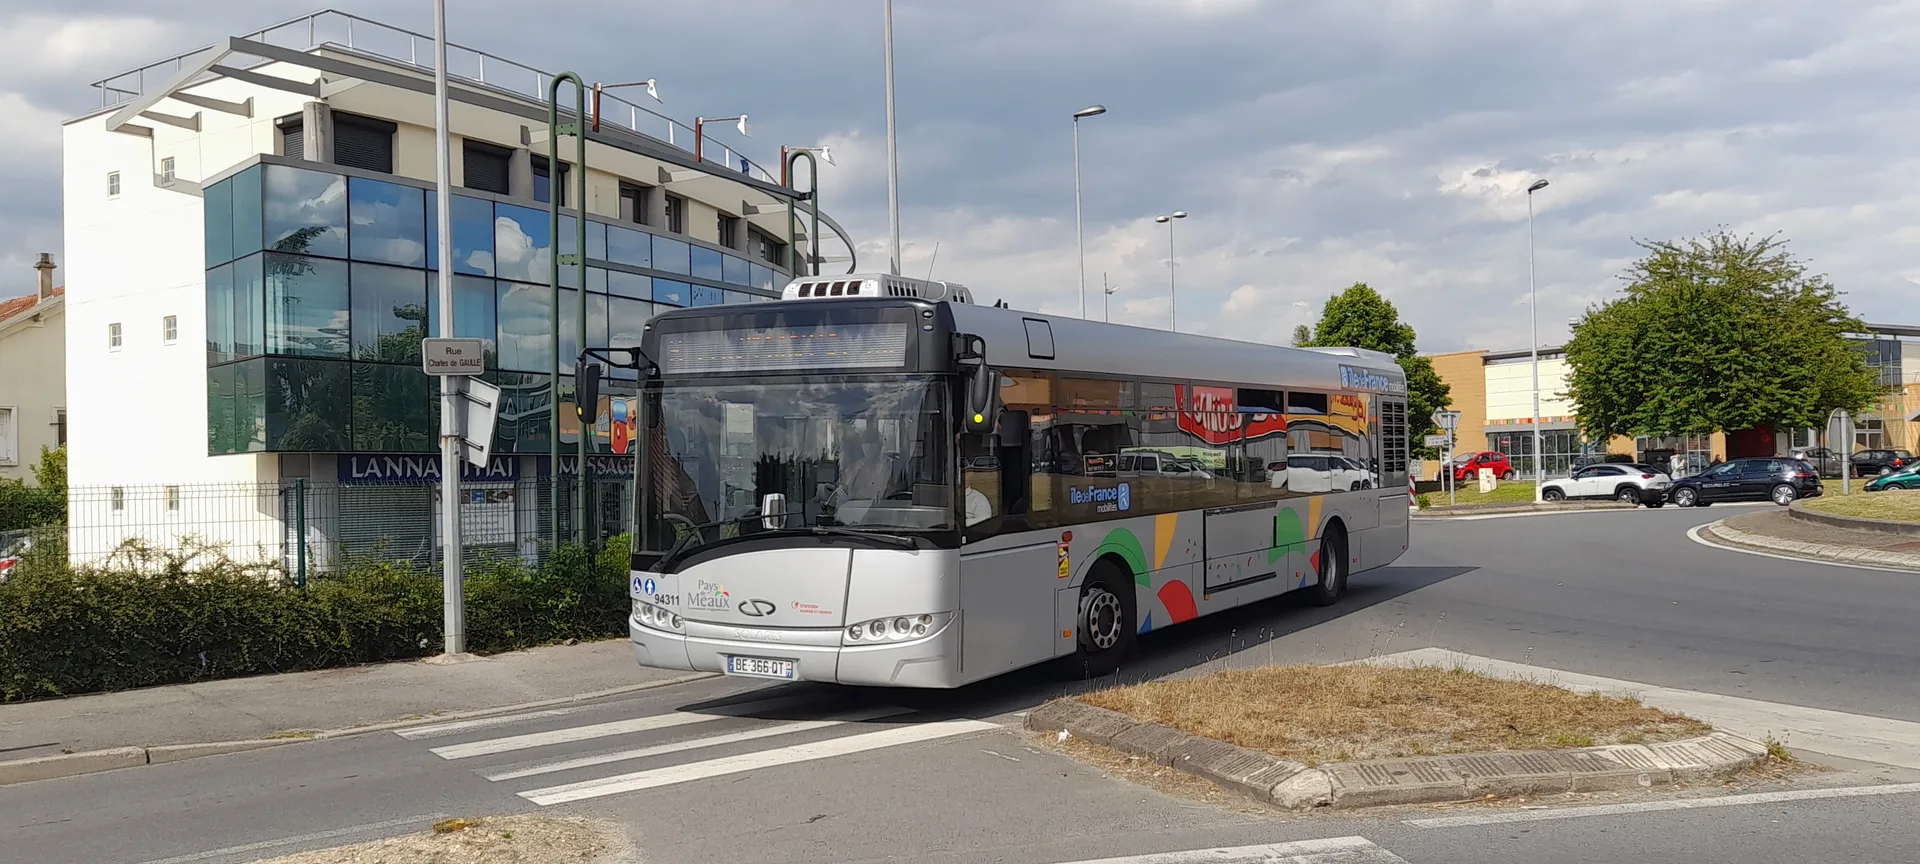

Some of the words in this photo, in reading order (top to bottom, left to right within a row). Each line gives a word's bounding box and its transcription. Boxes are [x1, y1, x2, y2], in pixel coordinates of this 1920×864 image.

[445, 346, 462, 355] Rue
[428, 358, 448, 367] Charles
[449, 358, 457, 367] de
[459, 358, 481, 367] GAULLE
[351, 456, 441, 478] LANNA
[558, 456, 635, 475] MSSAGE
[698, 579, 718, 595] Pays
[654, 593, 680, 606] 94311
[687, 592, 730, 609] Meaux
[733, 628, 783, 642] SOLARIS
[735, 658, 784, 675] BE-366-QT
